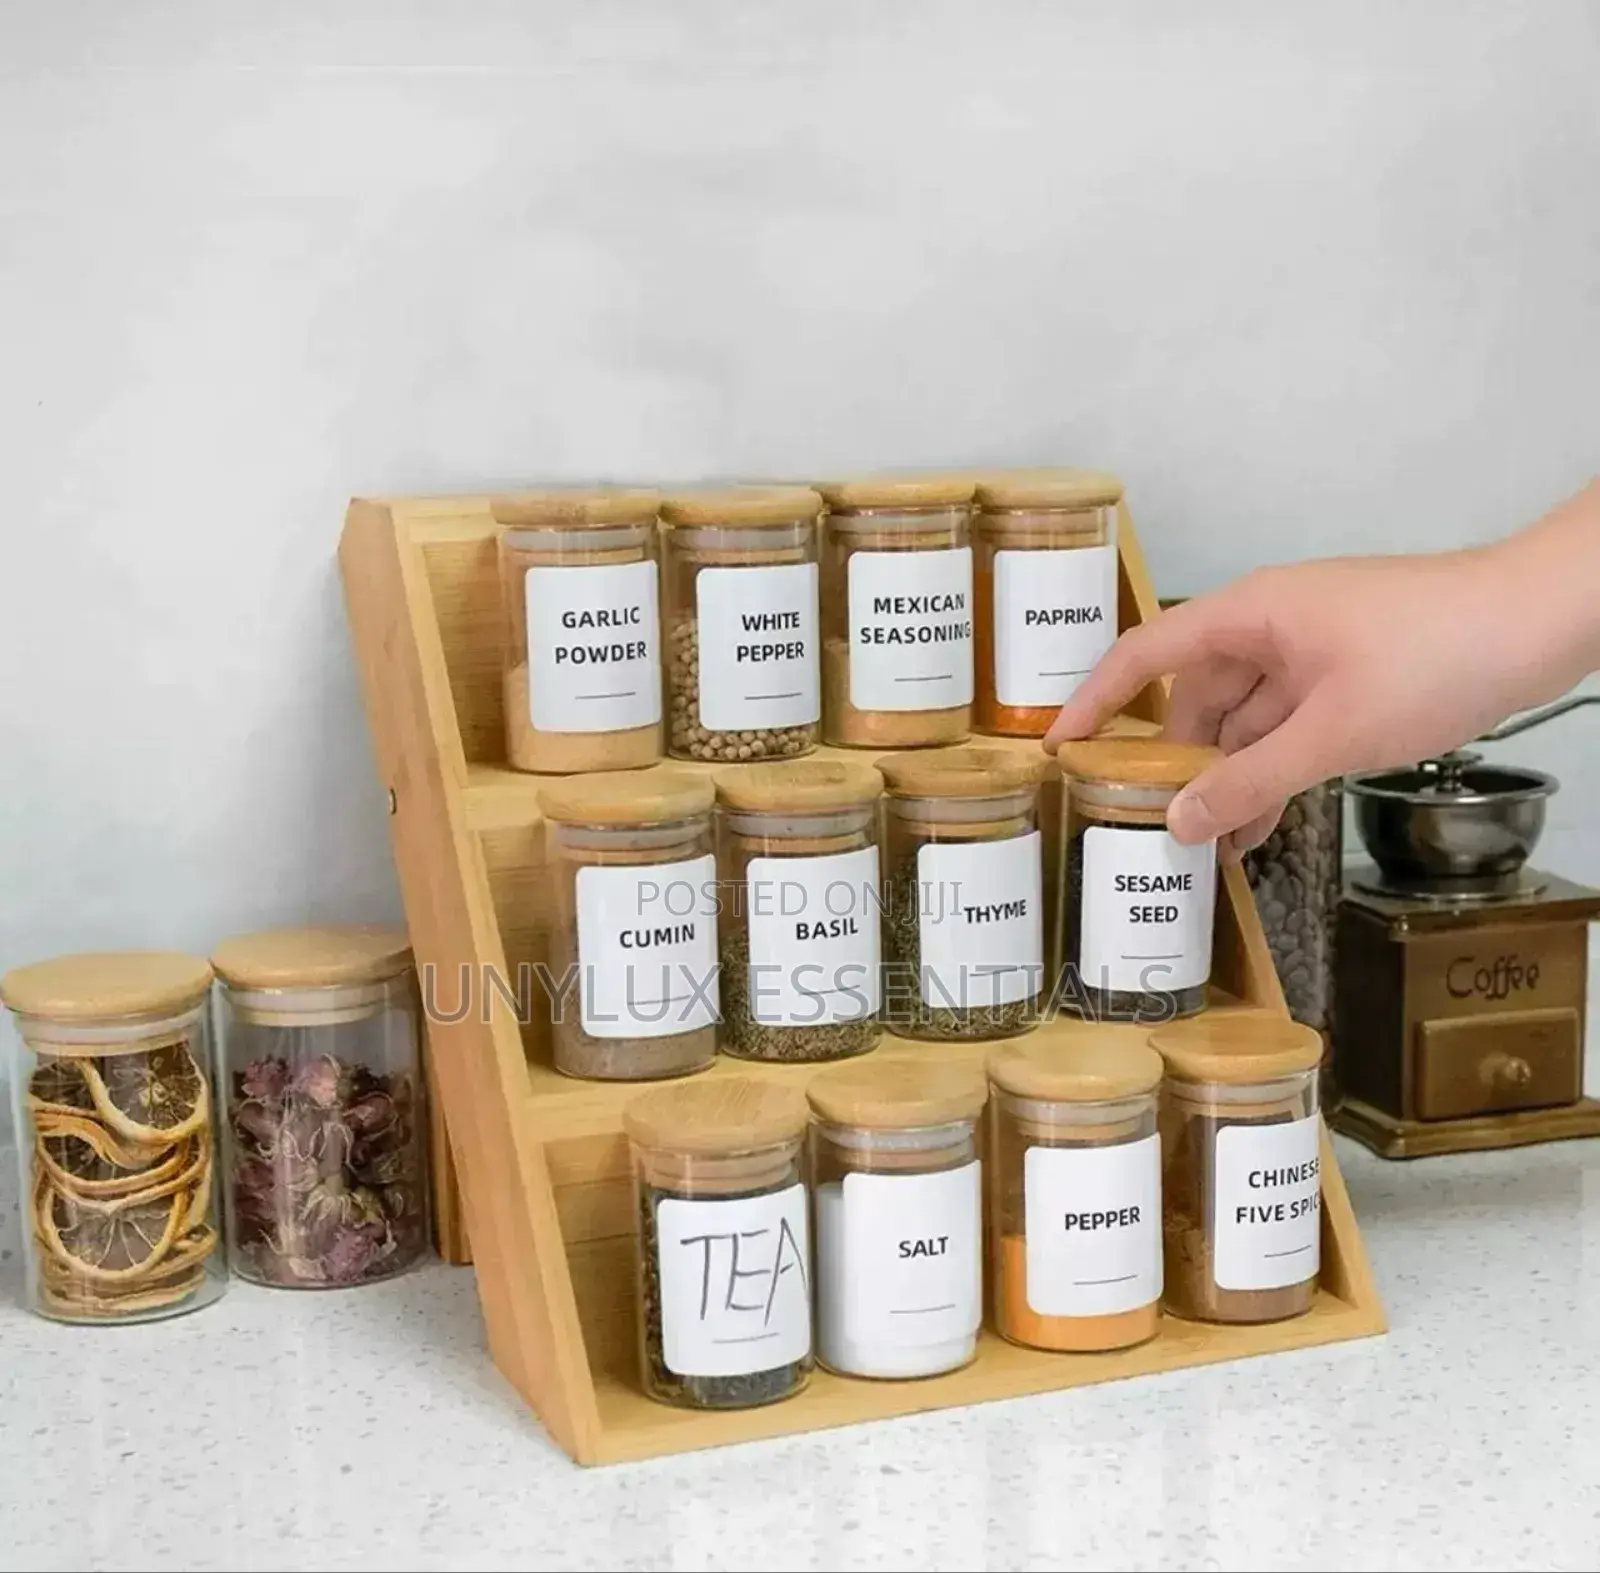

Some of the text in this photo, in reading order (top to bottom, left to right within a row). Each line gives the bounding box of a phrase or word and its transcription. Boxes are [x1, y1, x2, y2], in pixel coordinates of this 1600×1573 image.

[873, 593, 965, 615] MEXICAN
[561, 605, 642, 629] GARLIC
[741, 610, 801, 632] WHITE
[1024, 606, 1104, 627] PAPRIKA
[860, 620, 972, 645] SEASONING
[554, 641, 648, 666] POWDER
[735, 640, 805, 664] PEPPER
[1113, 874, 1192, 894] SESAME
[963, 899, 1028, 925] THYME
[1128, 905, 1178, 925] SEED
[619, 923, 695, 948] CUMIN
[795, 917, 859, 942] BASIL
[1446, 955, 1540, 1001] Coffee
[1064, 1207, 1141, 1232] PEPPER
[1236, 1204, 1285, 1224] FIVE
[898, 1236, 949, 1260] SALT
[680, 1217, 807, 1327] TEA
